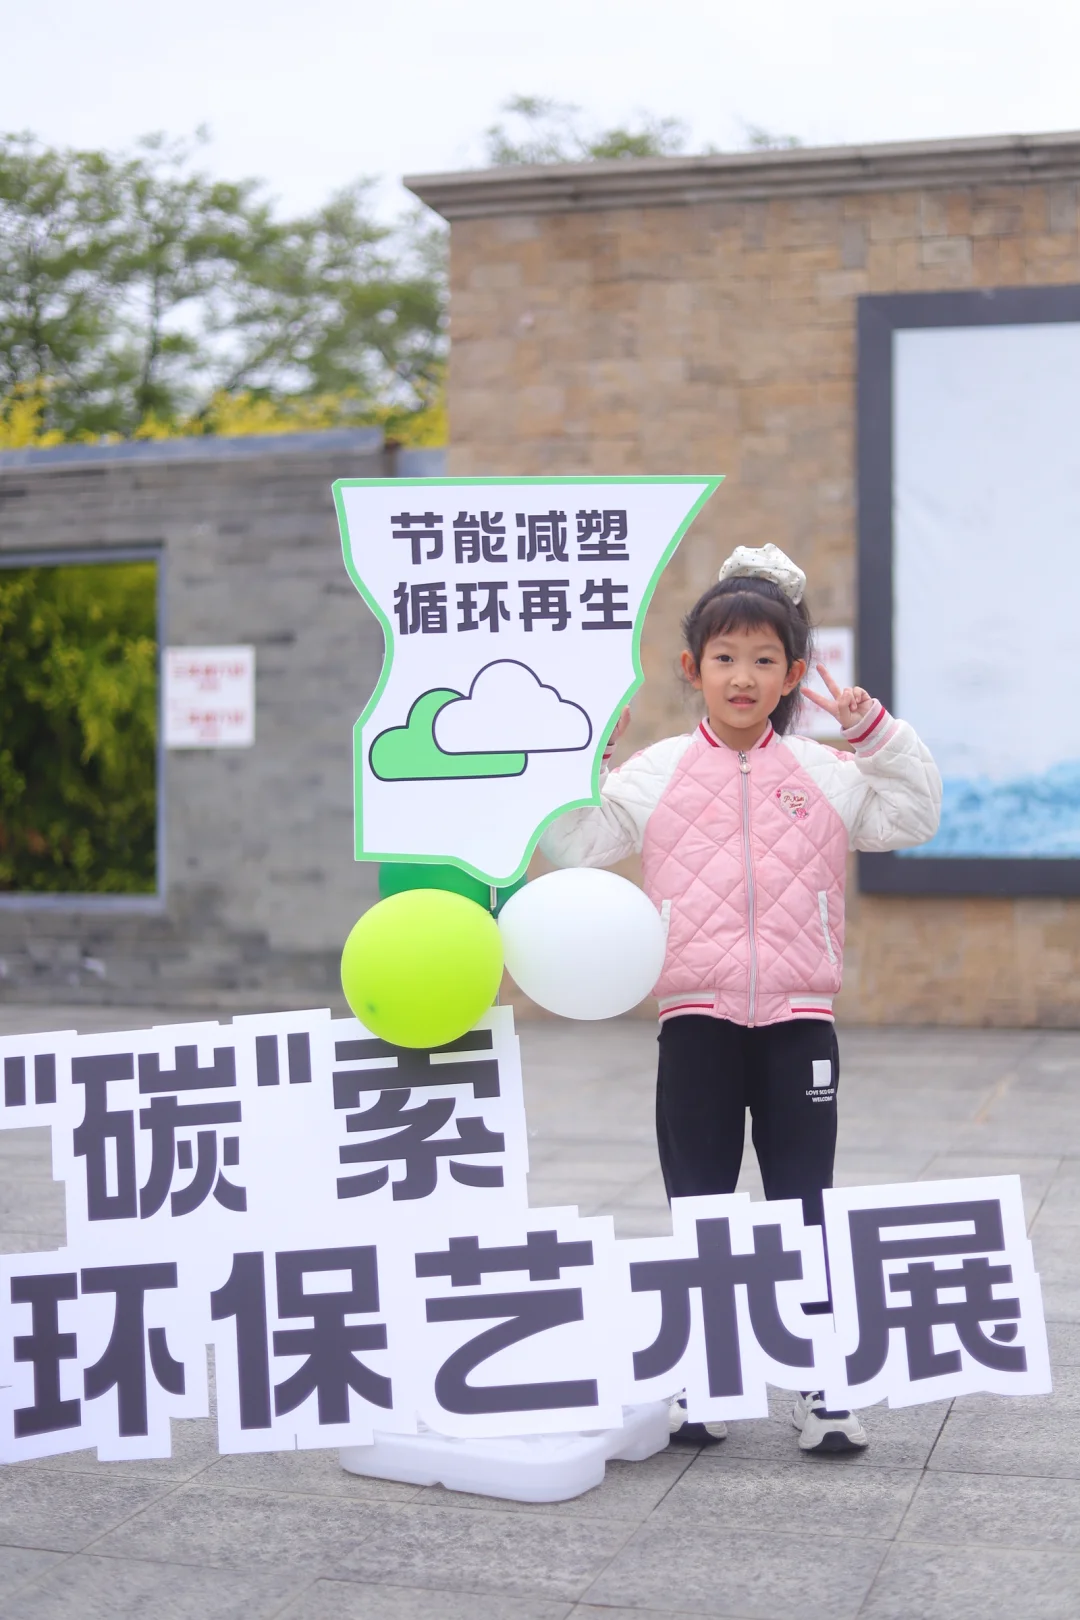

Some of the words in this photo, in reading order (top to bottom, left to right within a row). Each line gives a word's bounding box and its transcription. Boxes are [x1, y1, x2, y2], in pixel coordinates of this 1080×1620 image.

[390, 509, 630, 565] 节能减塑
[393, 578, 633, 635] 循环再生
[11, 1200, 1024, 1438] 环保艺术展
